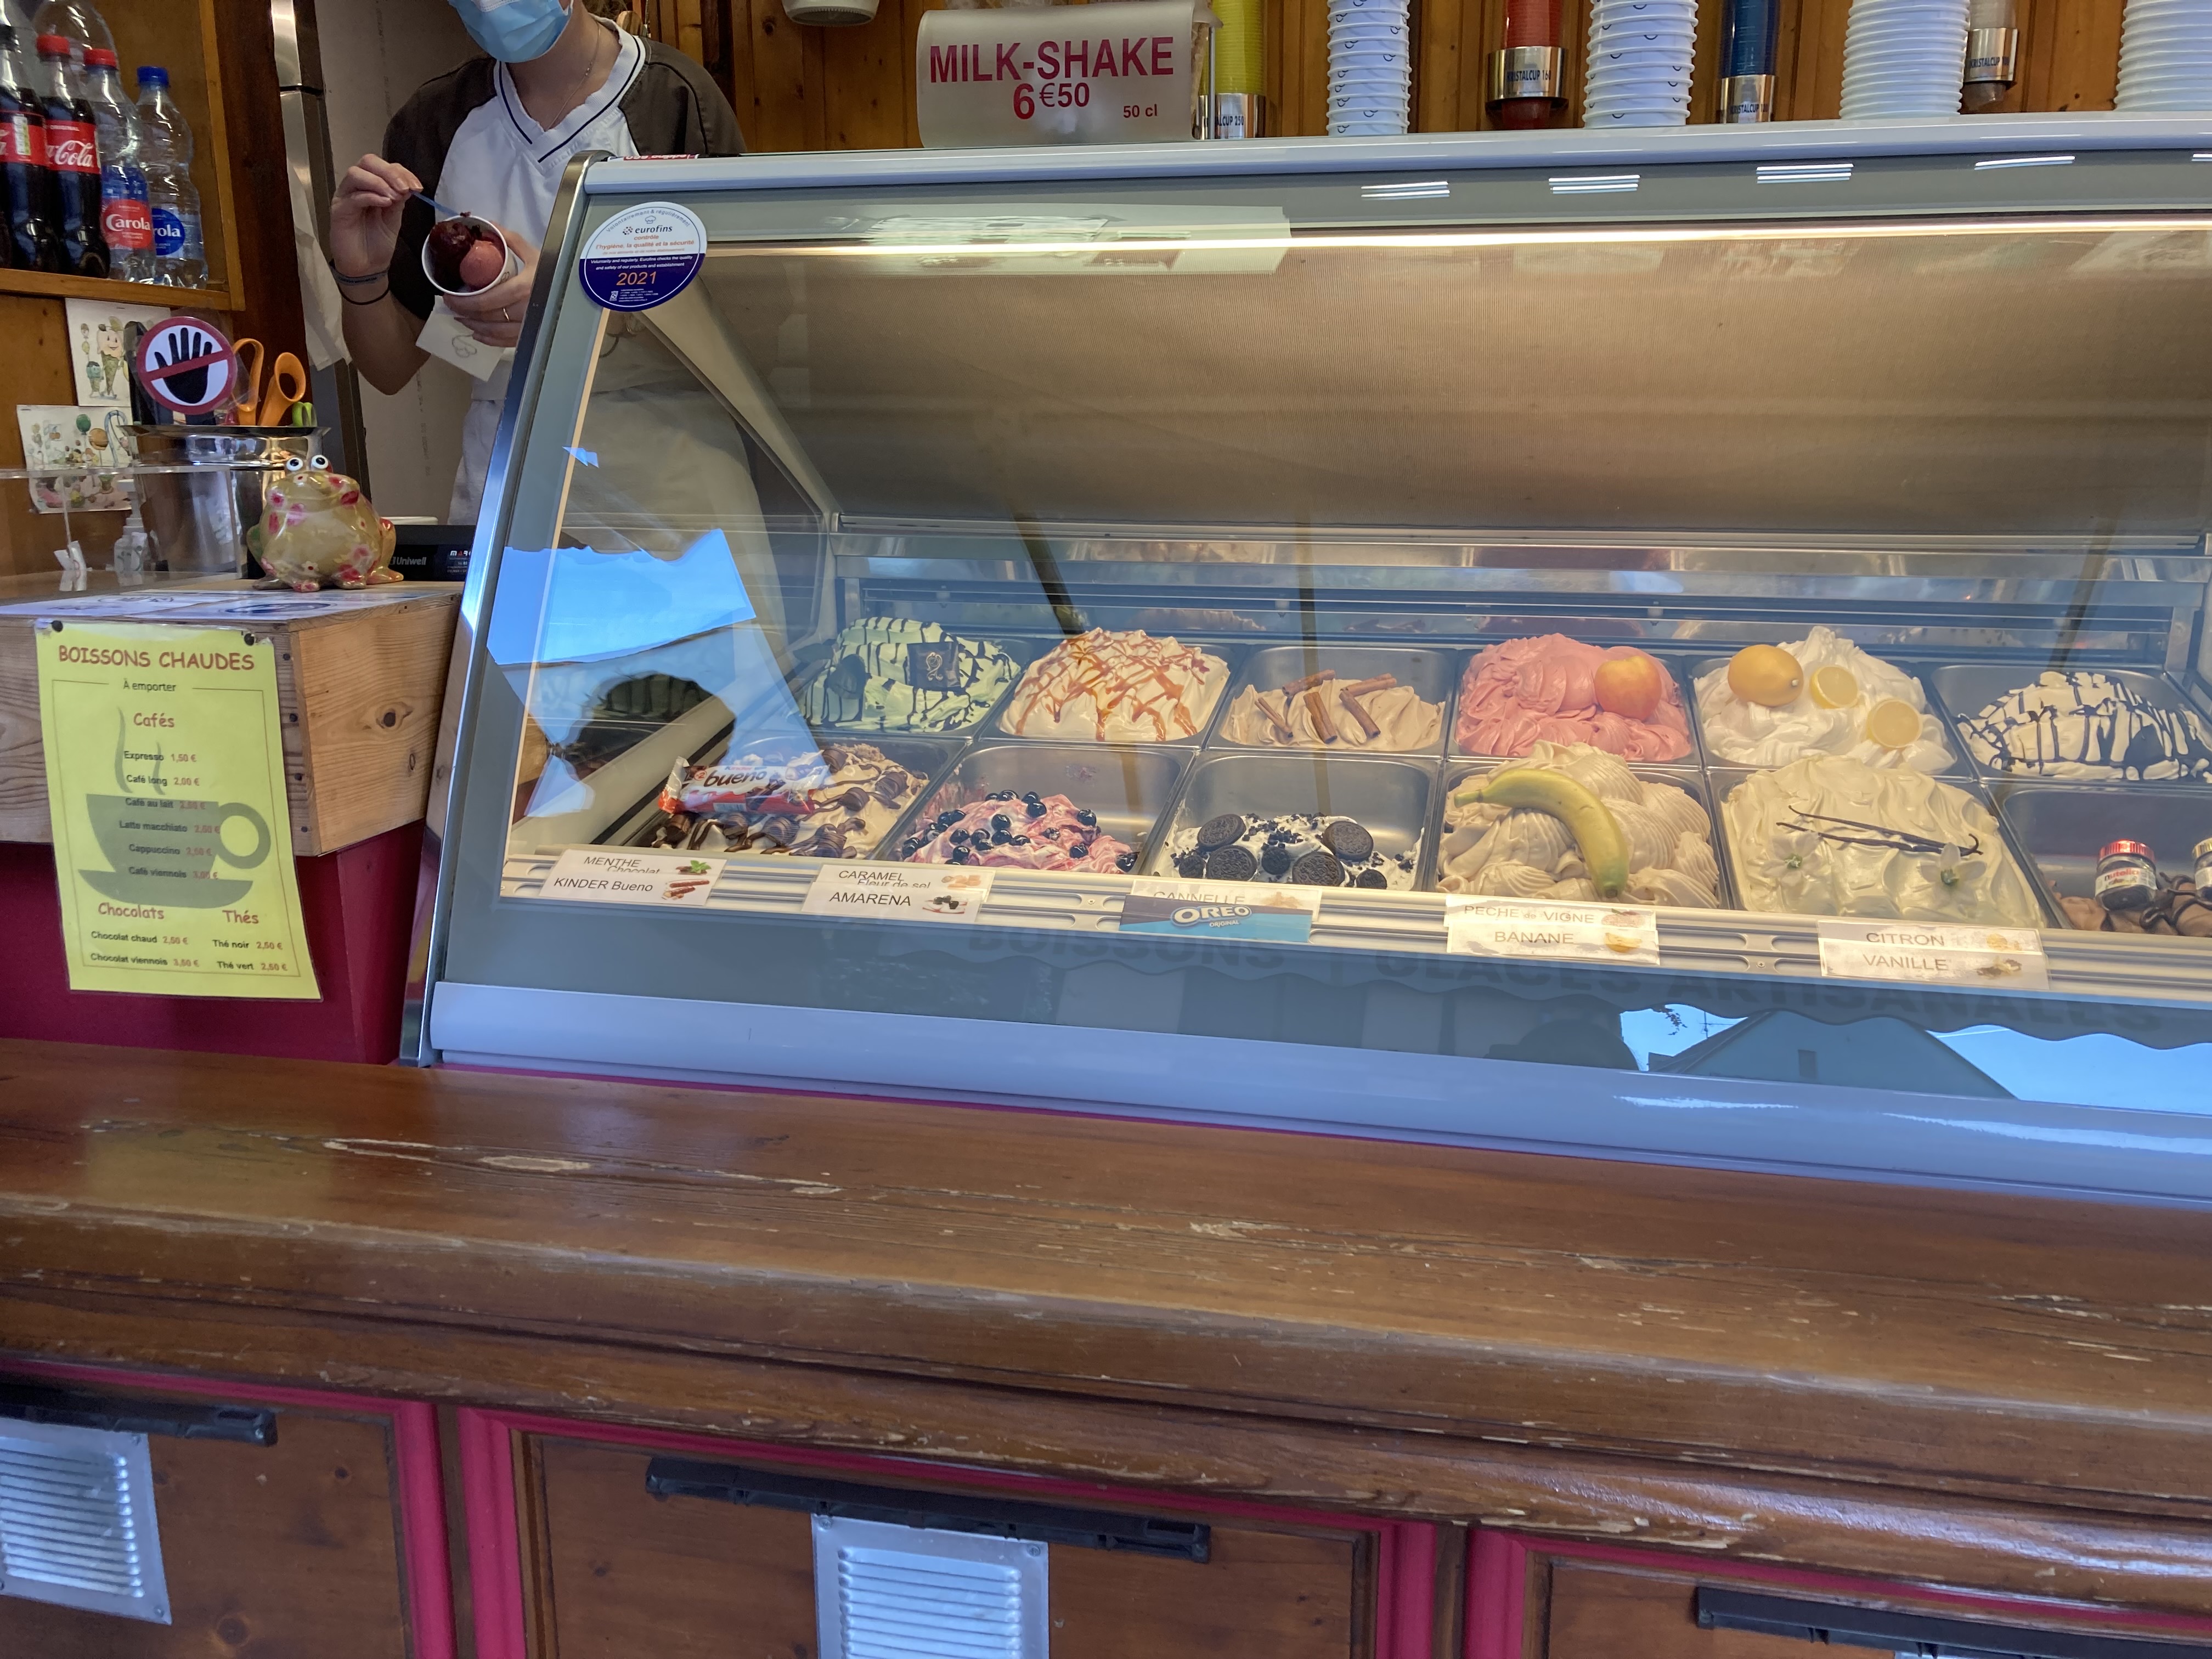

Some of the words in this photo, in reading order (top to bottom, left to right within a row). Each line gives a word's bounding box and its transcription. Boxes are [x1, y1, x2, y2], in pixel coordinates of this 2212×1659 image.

[930, 37, 1173, 83] MILK-SHAKE
[1507, 70, 1541, 82] KRISTALCUP
[1123, 105, 1140, 118] 50
[1145, 104, 1158, 116] cl
[1234, 116, 1244, 126] 250
[106, 214, 151, 232] Carola
[606, 210, 650, 233] Volontairement
[153, 224, 181, 237] rola
[635, 225, 673, 234] eurofins
[616, 272, 656, 286] 2021
[396, 557, 427, 565] Uniwell
[59, 645, 151, 668] BOISSONS
[159, 652, 255, 671] CHAUDES
[123, 678, 129, 690] À
[132, 682, 176, 692] emporter
[133, 713, 174, 727] Cafés
[124, 751, 164, 761] Expresso
[171, 754, 188, 763] 1,50
[127, 775, 145, 784] Café
[148, 776, 167, 787] long
[173, 777, 191, 786] 2,00
[704, 770, 768, 788] bueno
[125, 798, 145, 806] Café
[160, 800, 173, 808] lait
[119, 820, 140, 829] Latte
[143, 823, 188, 832] macchiato
[215, 825, 220, 833] €
[129, 844, 180, 855] Cappuccino
[584, 856, 641, 867] MENTHE
[128, 866, 148, 876] Café
[150, 868, 187, 878] viennois
[607, 866, 660, 874] Chocolat
[839, 870, 905, 882] CARAMEL
[2104, 868, 2139, 881] nutella
[554, 877, 608, 890] KINDER
[611, 881, 653, 891] Bueno
[830, 891, 911, 906] AMARENA
[98, 902, 165, 919] Chocolats
[222, 910, 259, 924] Thés
[1173, 905, 1250, 924] OREO
[1464, 905, 1519, 918] PECHE
[1543, 911, 1595, 923] VIGNE
[91, 931, 129, 941] Chocolat
[131, 934, 157, 943] chaud
[1494, 932, 1574, 944] BANANE
[1866, 933, 1944, 946] CITRON
[212, 939, 229, 947] Thé
[256, 941, 274, 950] 2,50
[91, 953, 129, 963] Chocolat
[131, 956, 168, 966] viennois
[1863, 954, 1947, 971] VANILLE
[261, 963, 279, 972] 2,50
